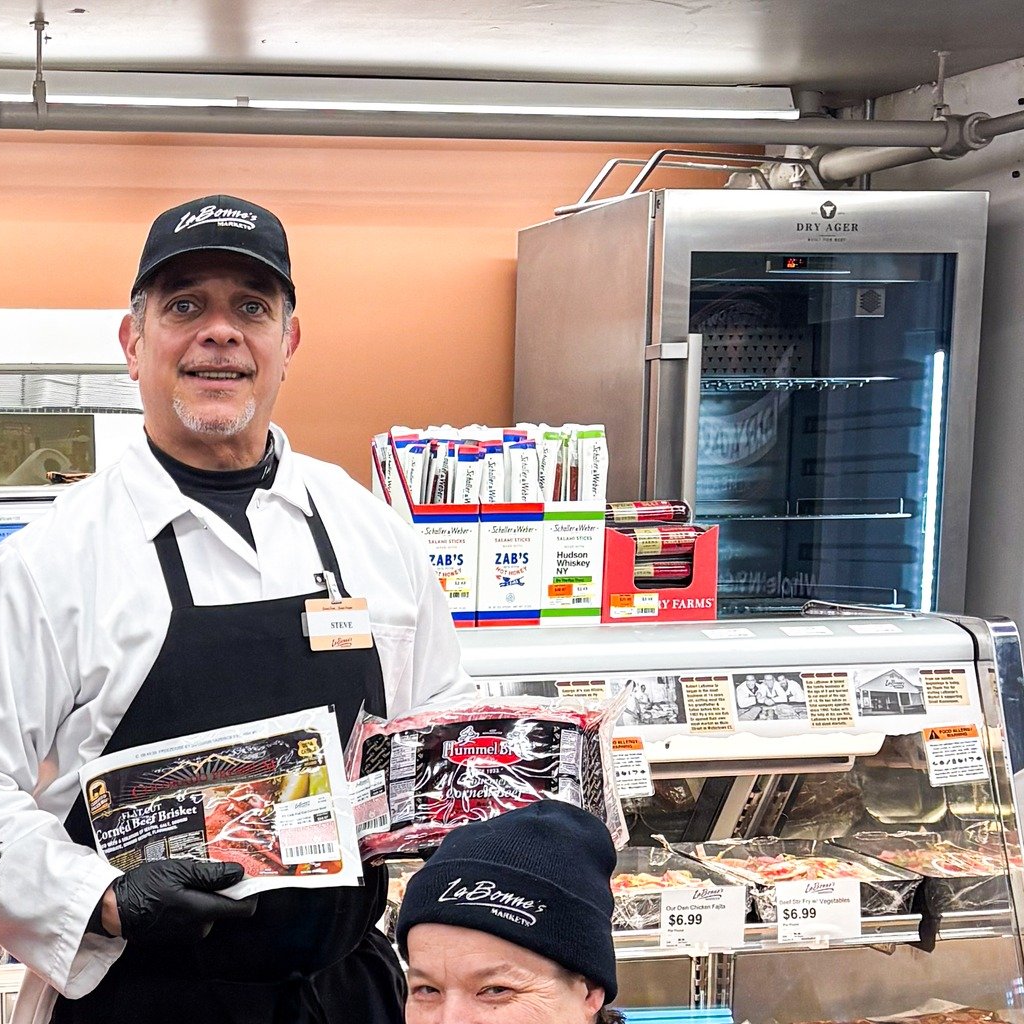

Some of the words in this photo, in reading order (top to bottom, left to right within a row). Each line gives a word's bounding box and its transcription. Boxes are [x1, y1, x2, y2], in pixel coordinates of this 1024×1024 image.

[174, 205, 257, 234] LaBonne's
[217, 221, 252, 231] MARKETS
[796, 223, 821, 232] DRY
[825, 223, 859, 232] AGER
[491, 526, 513, 534] Schaller
[554, 524, 575, 532] Schaller
[429, 554, 464, 566] ZAB'S
[495, 552, 529, 565] ZAB'S
[557, 551, 588, 559] Hudson
[557, 559, 590, 568] Whiskey
[556, 567, 568, 575] NY
[672, 599, 712, 609] FARMS
[331, 621, 353, 629] STEVE
[442, 740, 497, 758] Hummel
[96, 822, 131, 841] Corned
[133, 812, 158, 829] Beef
[158, 805, 197, 823] Brisket
[438, 878, 547, 913] LaBonne's
[820, 897, 851, 905] Vegetables
[490, 908, 531, 927] MARKETS
[783, 908, 816, 921] $6.99
[668, 913, 703, 927] $6.99
